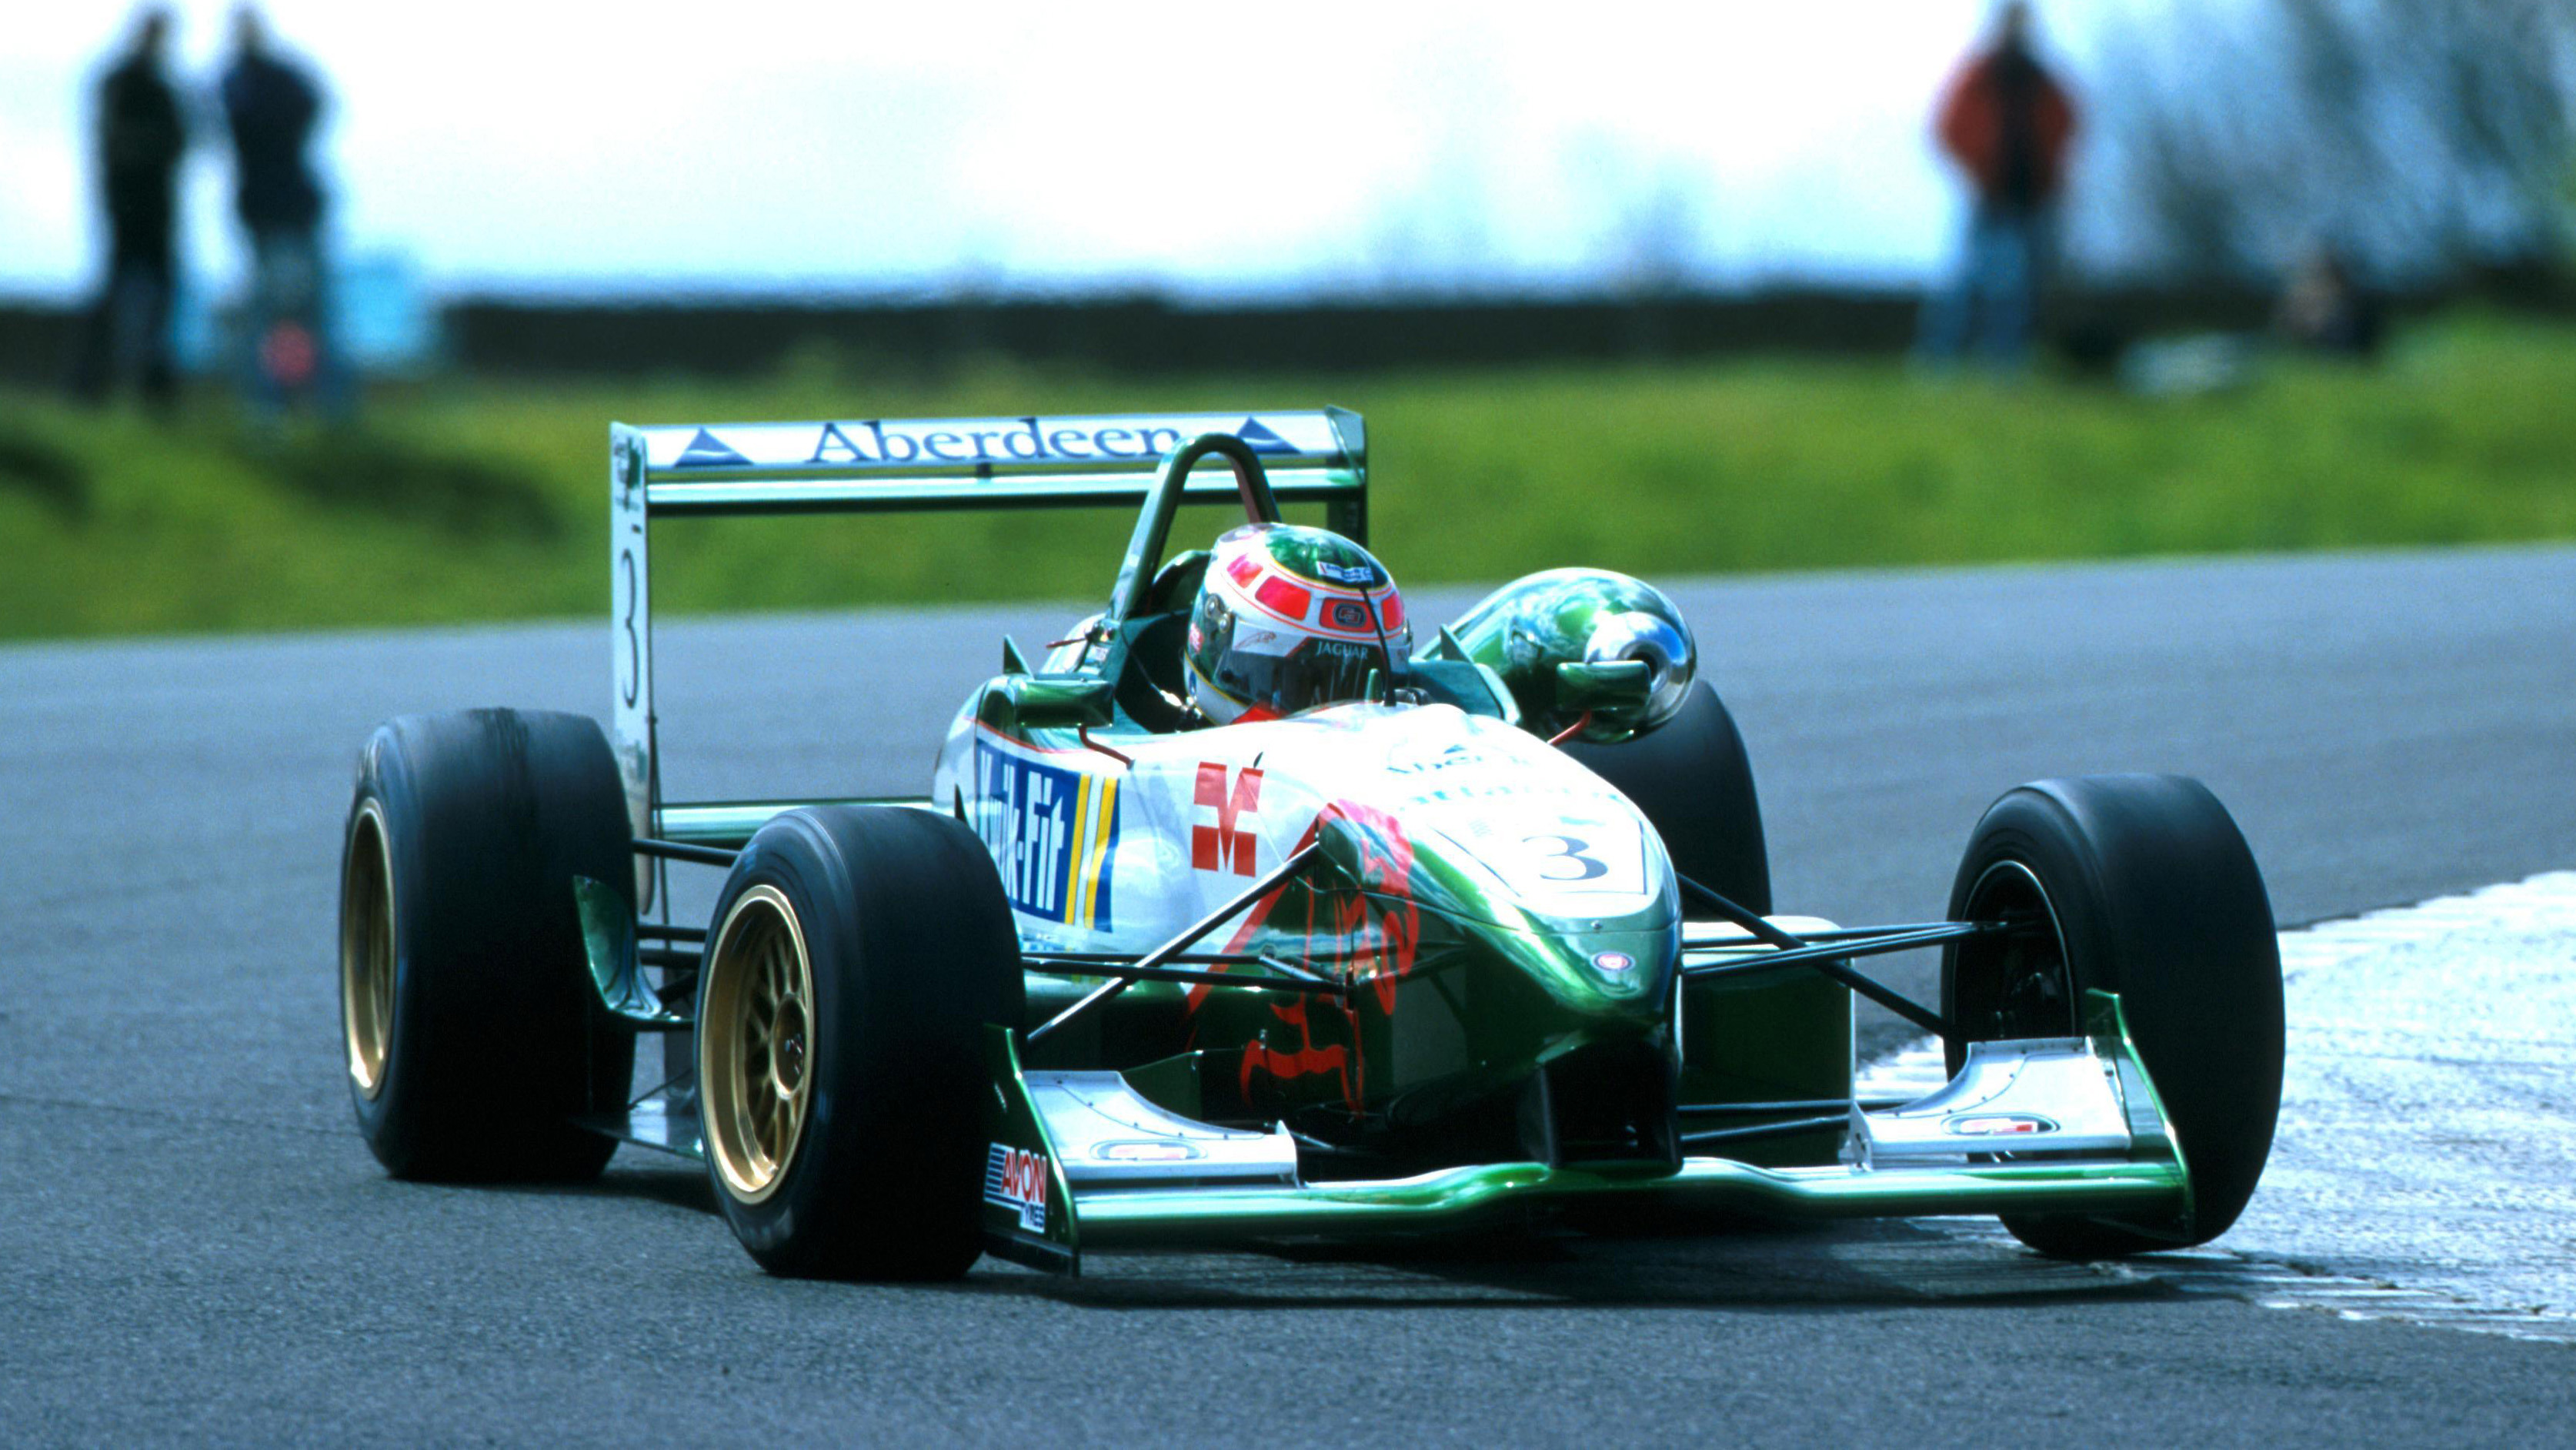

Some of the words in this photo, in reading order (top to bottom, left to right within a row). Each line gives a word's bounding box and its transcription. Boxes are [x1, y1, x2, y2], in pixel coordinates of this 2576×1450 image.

[804, 416, 1182, 463] Aberdeen
[622, 548, 639, 710] 3
[1316, 640, 1368, 660] JAGUAR
[1522, 835, 1609, 880] 3
[1000, 1151, 1046, 1202] AVON
